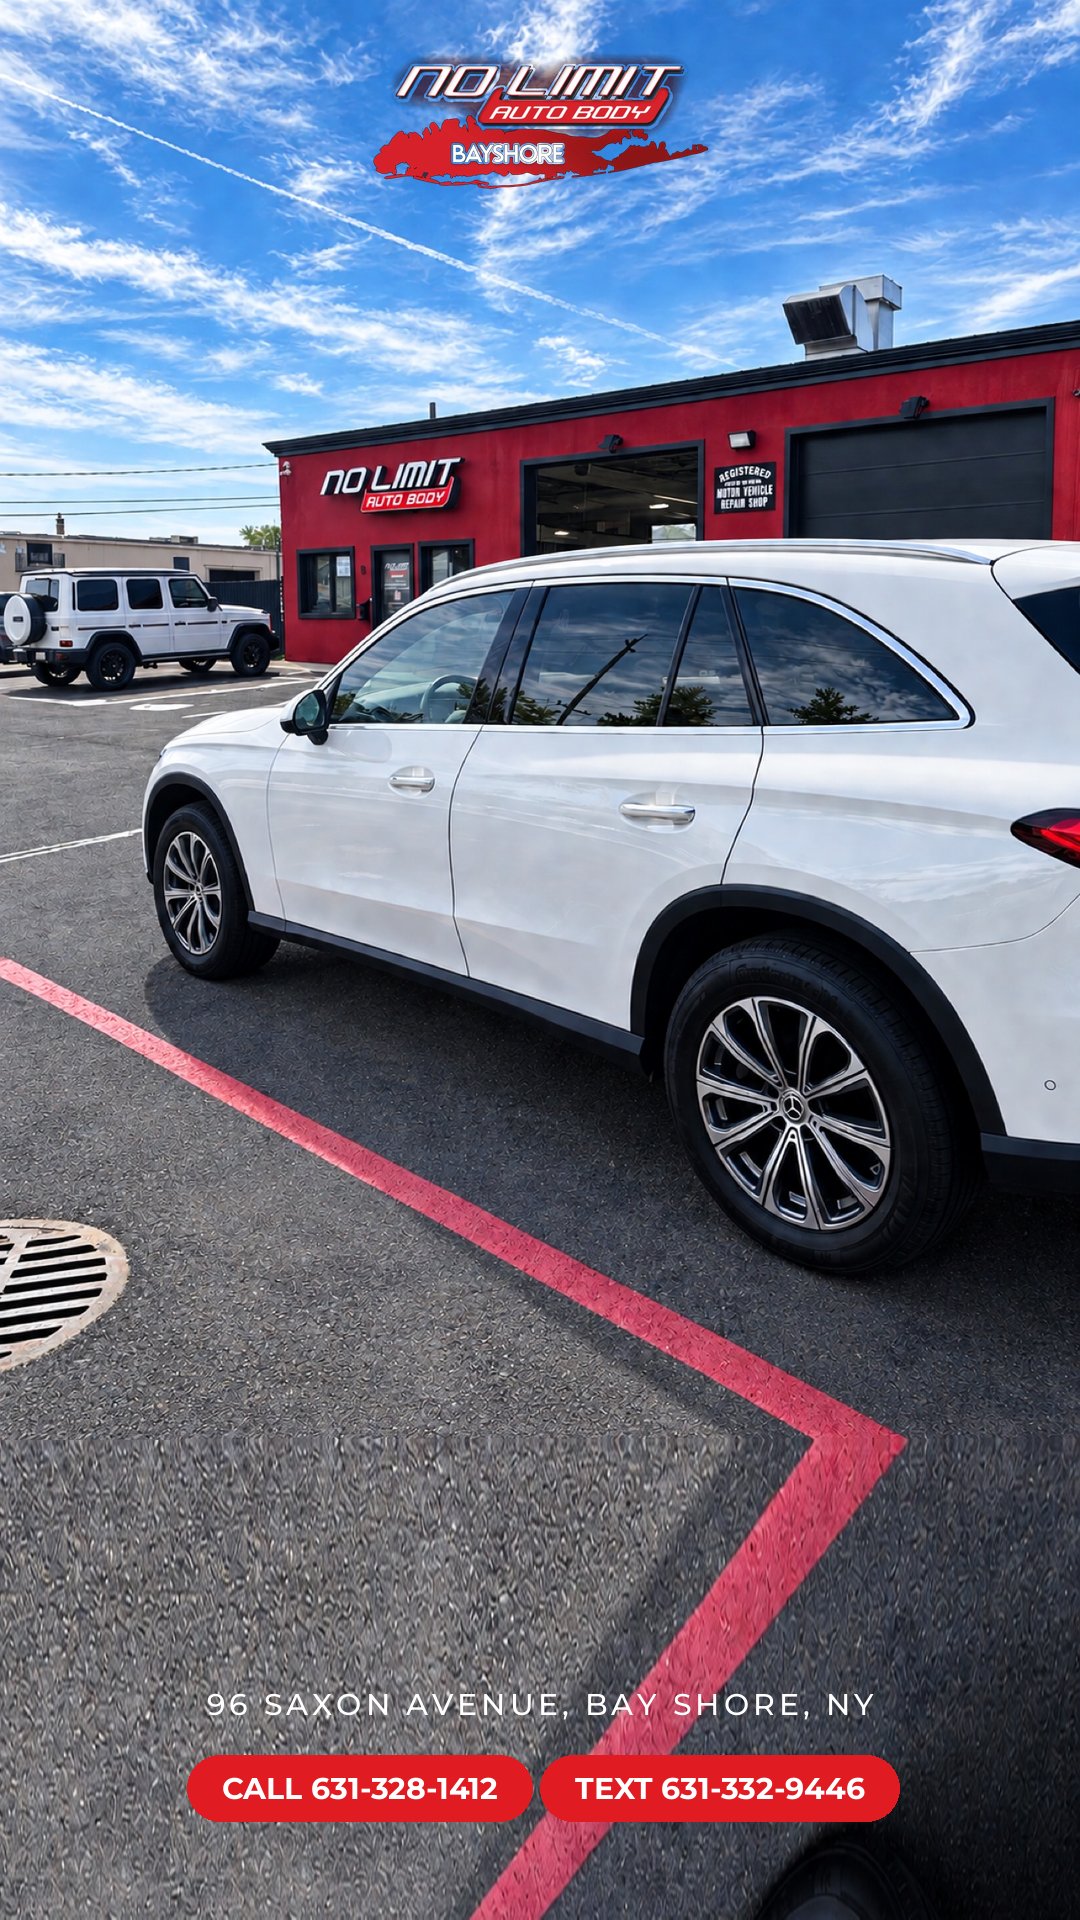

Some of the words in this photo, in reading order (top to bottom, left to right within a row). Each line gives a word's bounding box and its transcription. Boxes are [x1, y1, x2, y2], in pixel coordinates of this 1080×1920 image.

[320, 467, 367, 495] NO
[371, 457, 461, 491] LIMIT
[719, 466, 771, 482] REGISTERED
[366, 495, 403, 508] AUTO
[406, 491, 445, 505] BODY
[717, 487, 740, 499] MOTOR
[743, 484, 773, 496] VEHICLE
[721, 498, 745, 509] REPAIR
[748, 497, 768, 508] SHOP
